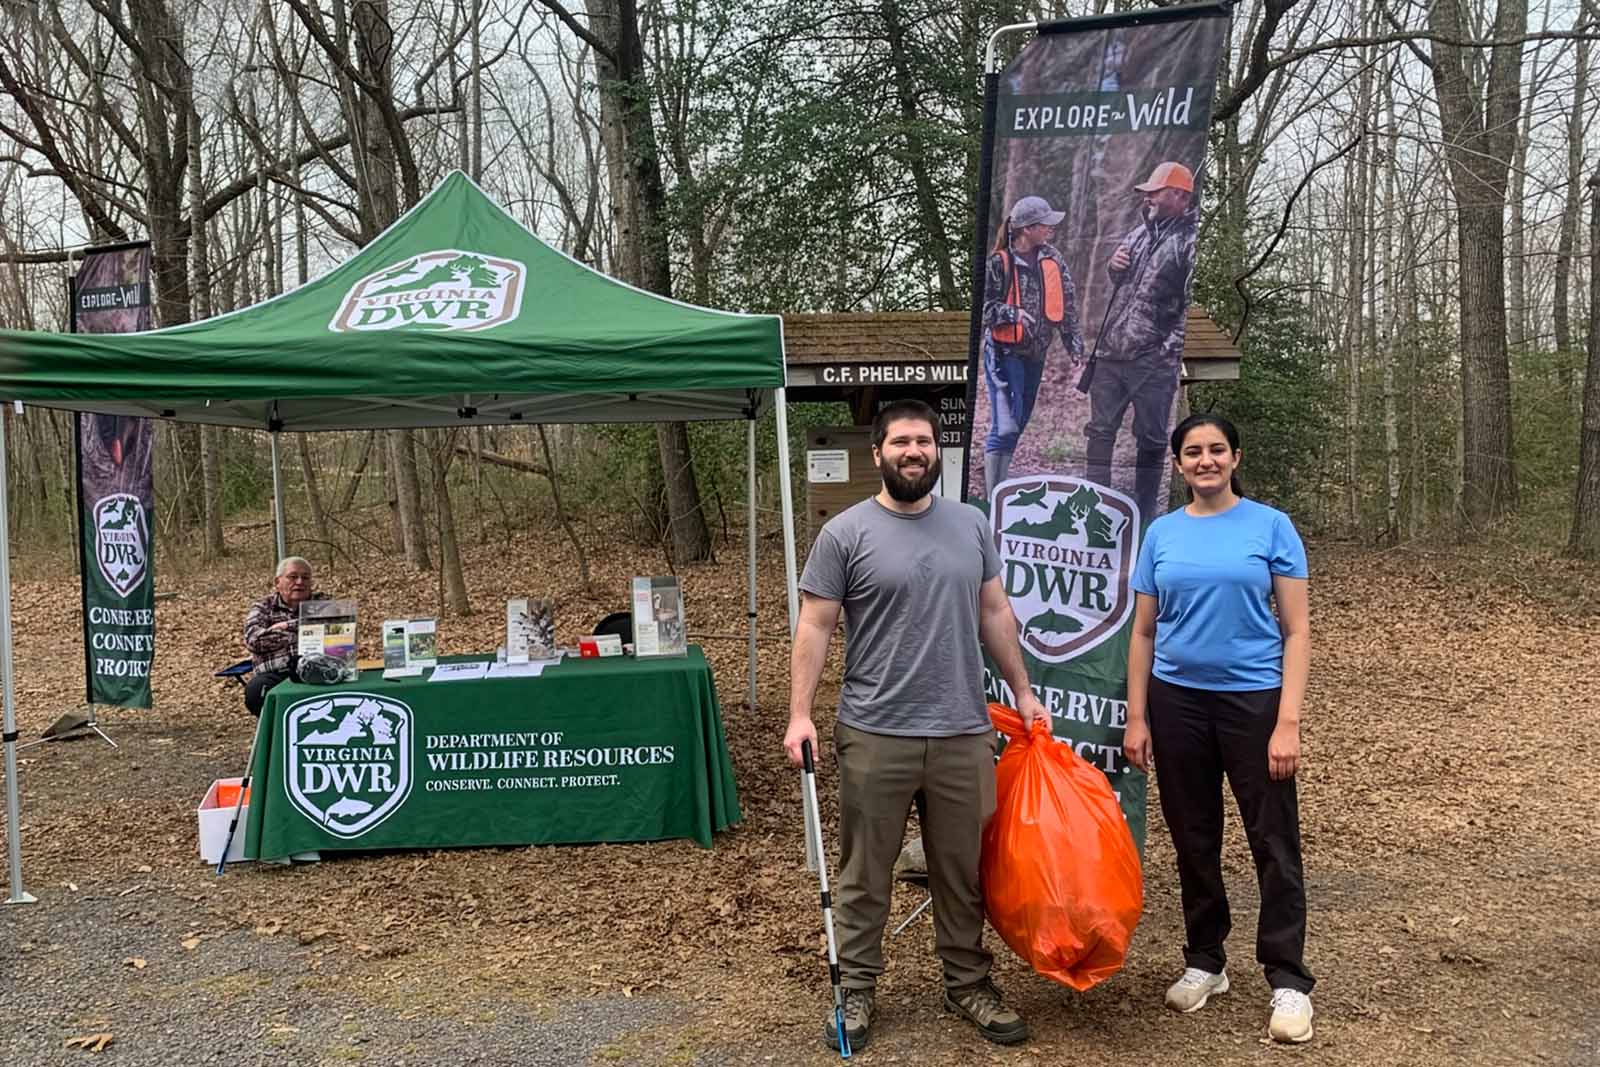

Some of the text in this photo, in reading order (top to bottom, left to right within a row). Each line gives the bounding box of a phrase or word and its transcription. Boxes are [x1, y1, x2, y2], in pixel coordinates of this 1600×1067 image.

[1013, 87, 1194, 131] EXPLORE Wild
[352, 300, 494, 326] DWR
[823, 366, 853, 383] C.F.
[859, 365, 926, 382] PHELPS
[1004, 559, 1112, 612] DWR
[425, 731, 564, 749] DEPARTMENT OF
[302, 747, 395, 761] VIRGINIA
[426, 745, 675, 771] WILDLIFE RESOURCES
[301, 762, 396, 794] DWR
[561, 774, 621, 788] PROTECT.
